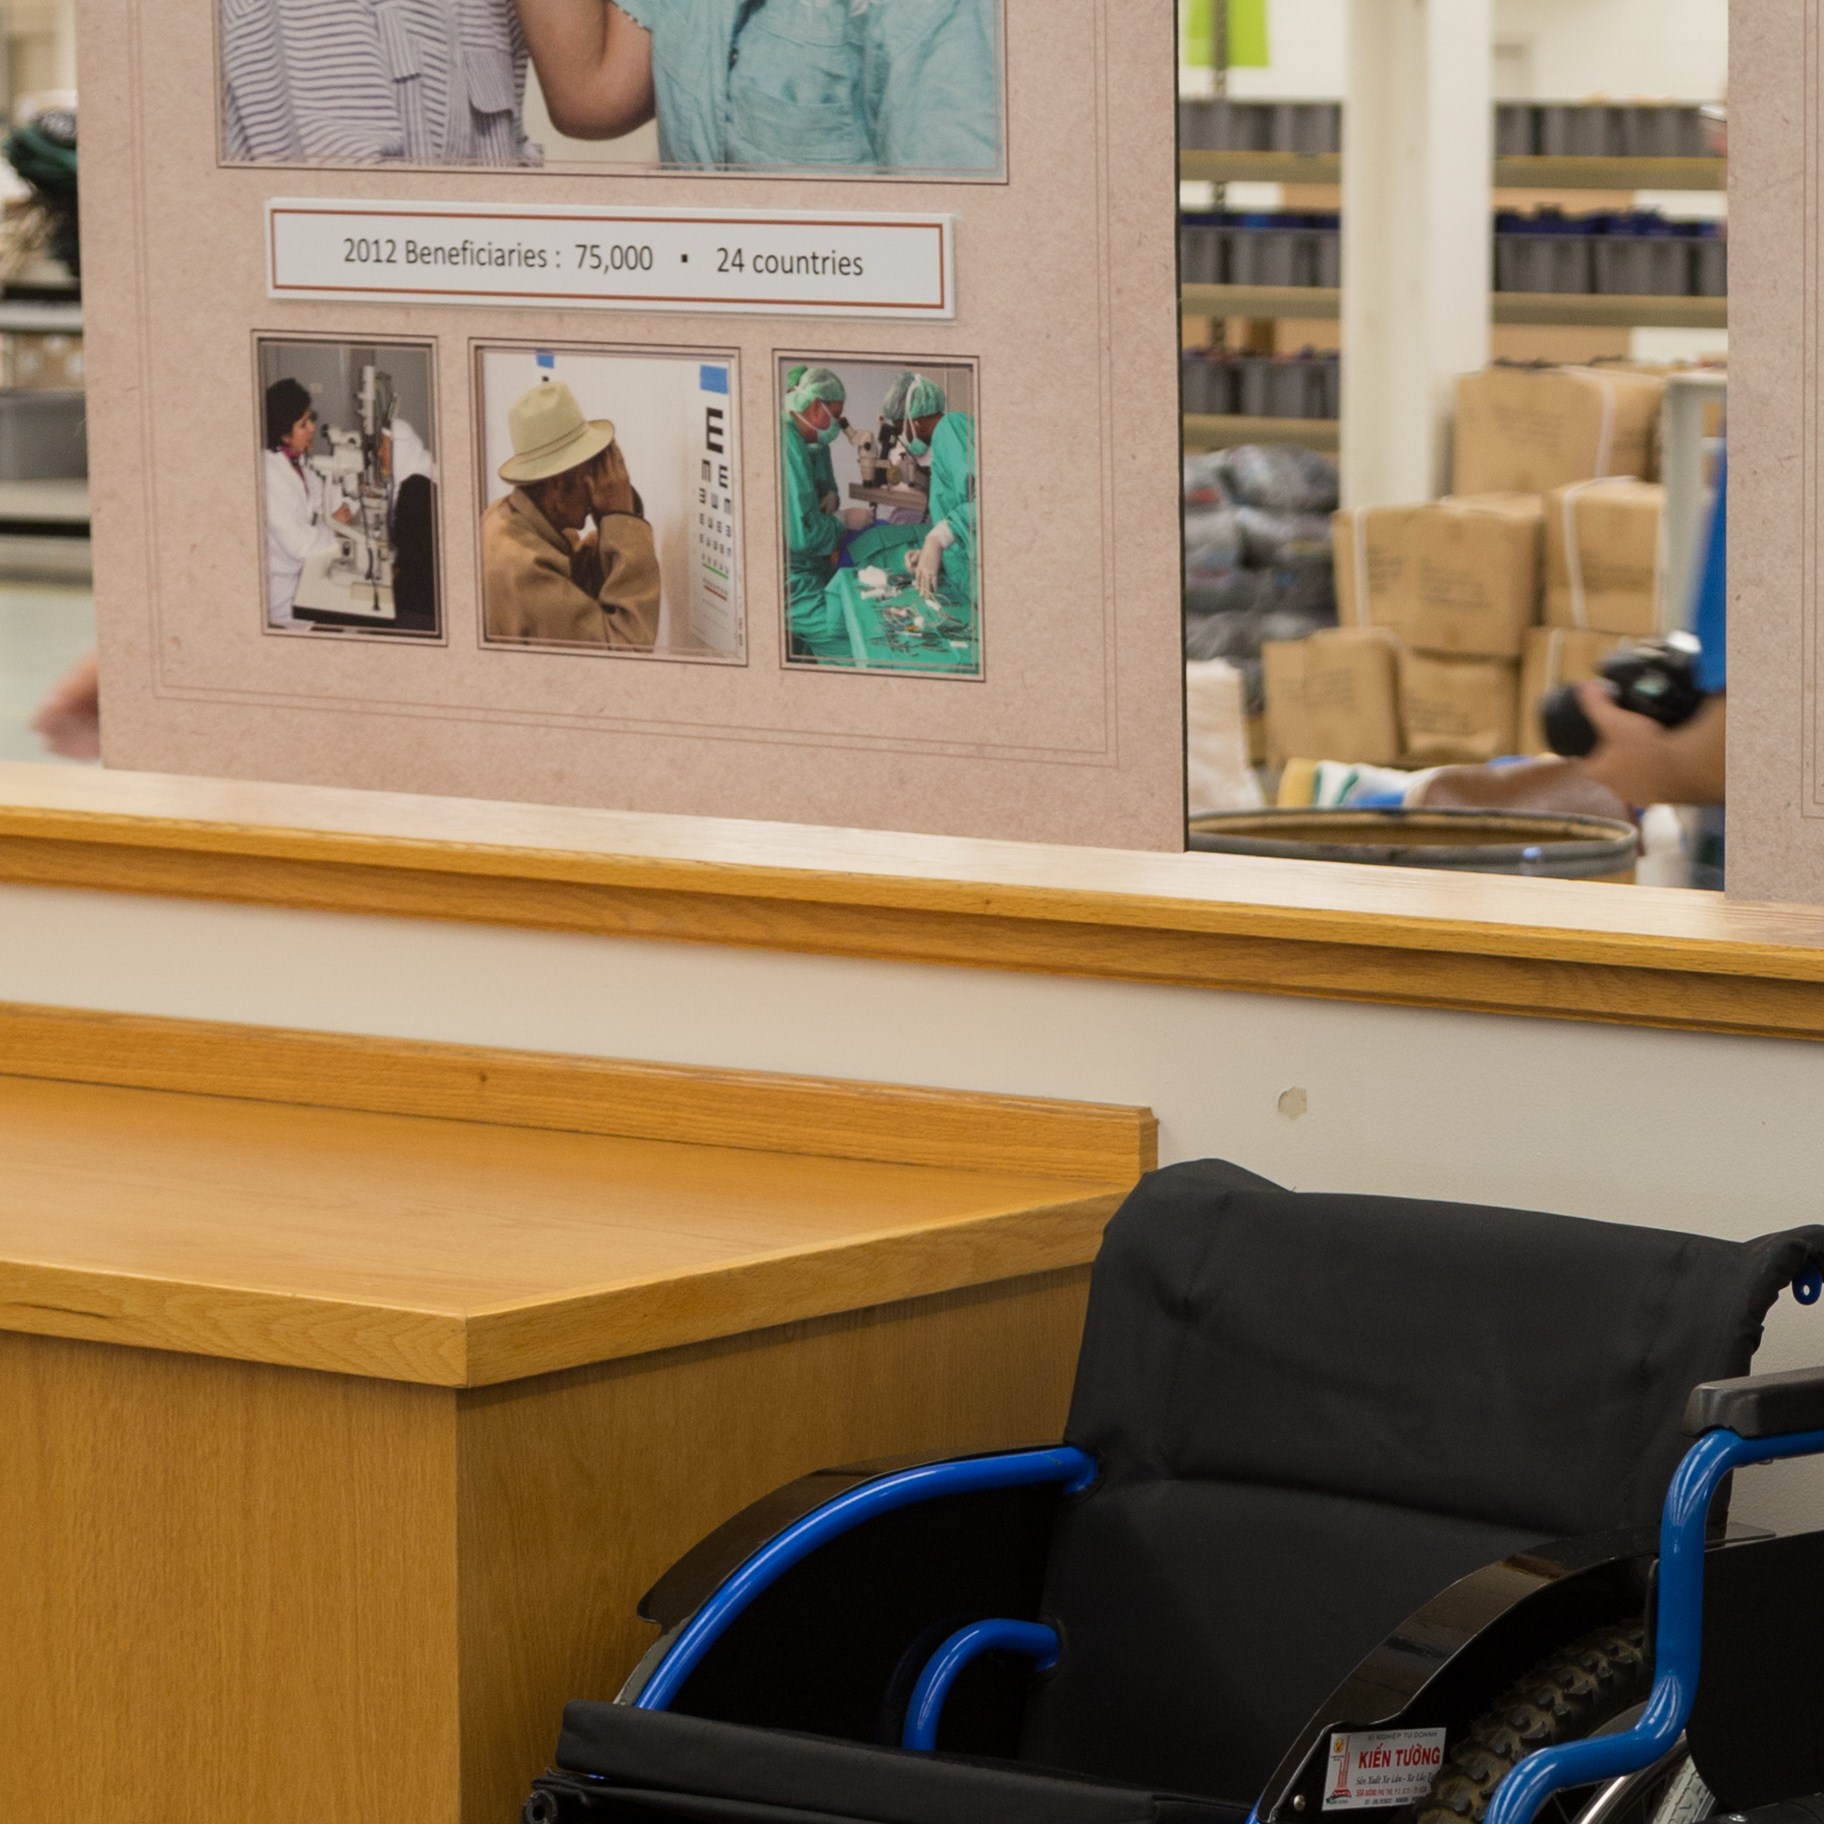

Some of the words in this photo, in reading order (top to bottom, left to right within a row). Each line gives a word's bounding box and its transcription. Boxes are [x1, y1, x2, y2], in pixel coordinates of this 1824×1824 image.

[342, 237, 398, 265] 2012
[404, 239, 549, 269] Beneficiaries
[574, 244, 654, 274] 75,000
[716, 247, 745, 274] 24
[752, 249, 864, 276] countries
